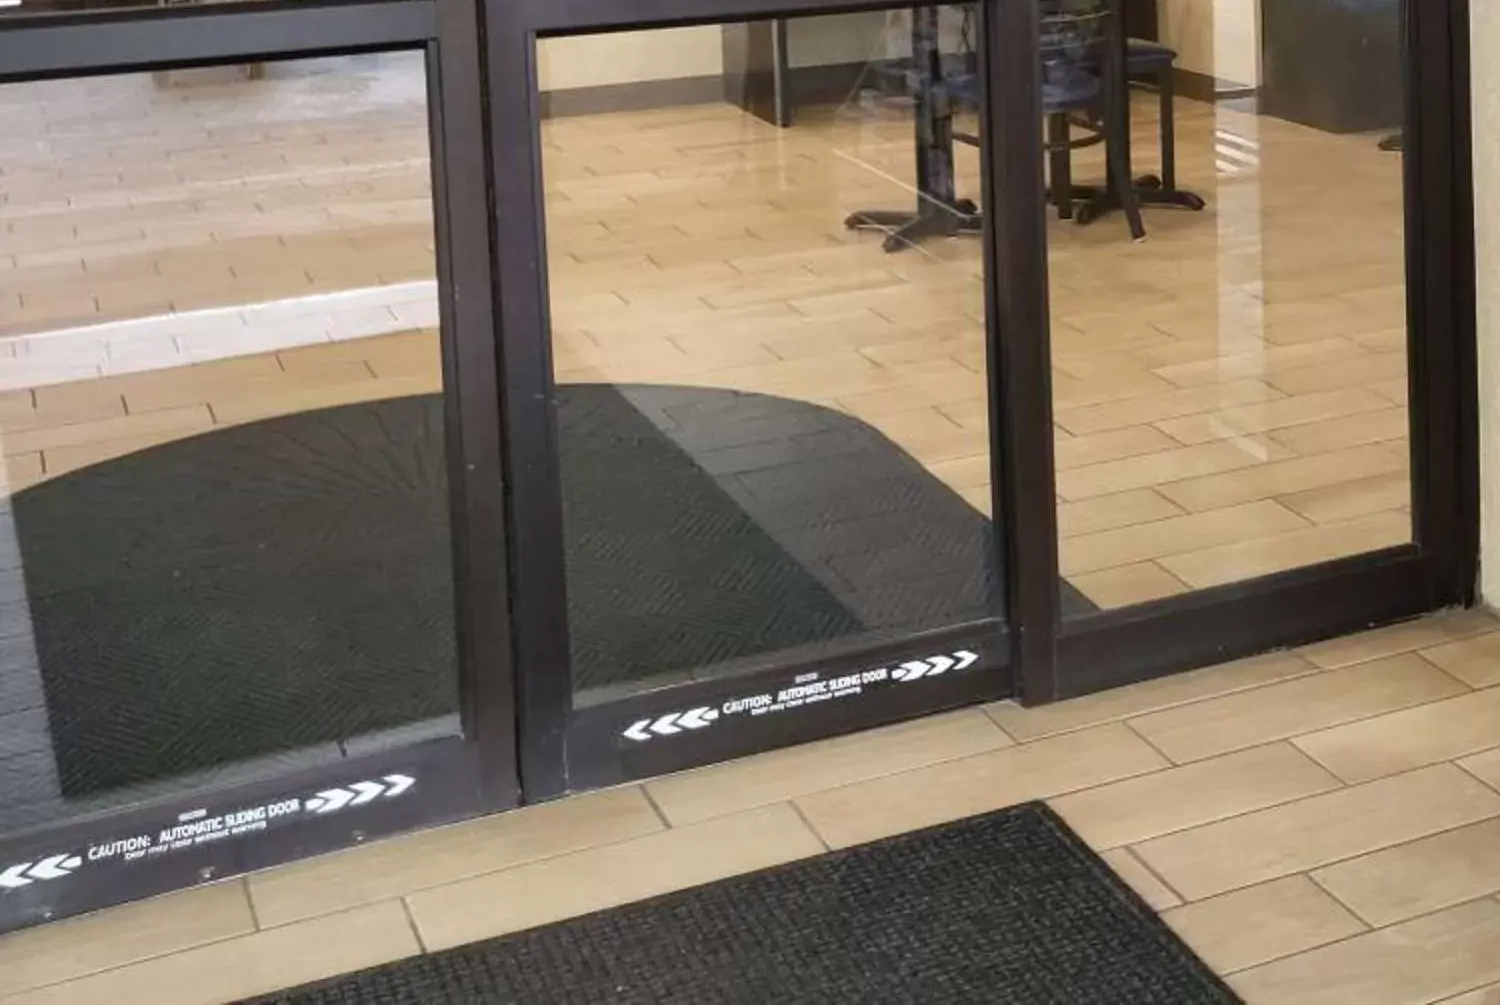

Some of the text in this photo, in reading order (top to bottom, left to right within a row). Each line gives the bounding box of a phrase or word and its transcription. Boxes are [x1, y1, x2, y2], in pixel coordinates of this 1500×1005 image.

[722, 694, 772, 714] CAUTION:
[777, 681, 828, 702] AUTOMATIC
[861, 668, 888, 684] DOOR
[88, 798, 300, 860] CAUTION: AUTOMATIC SLIDING DOOR
